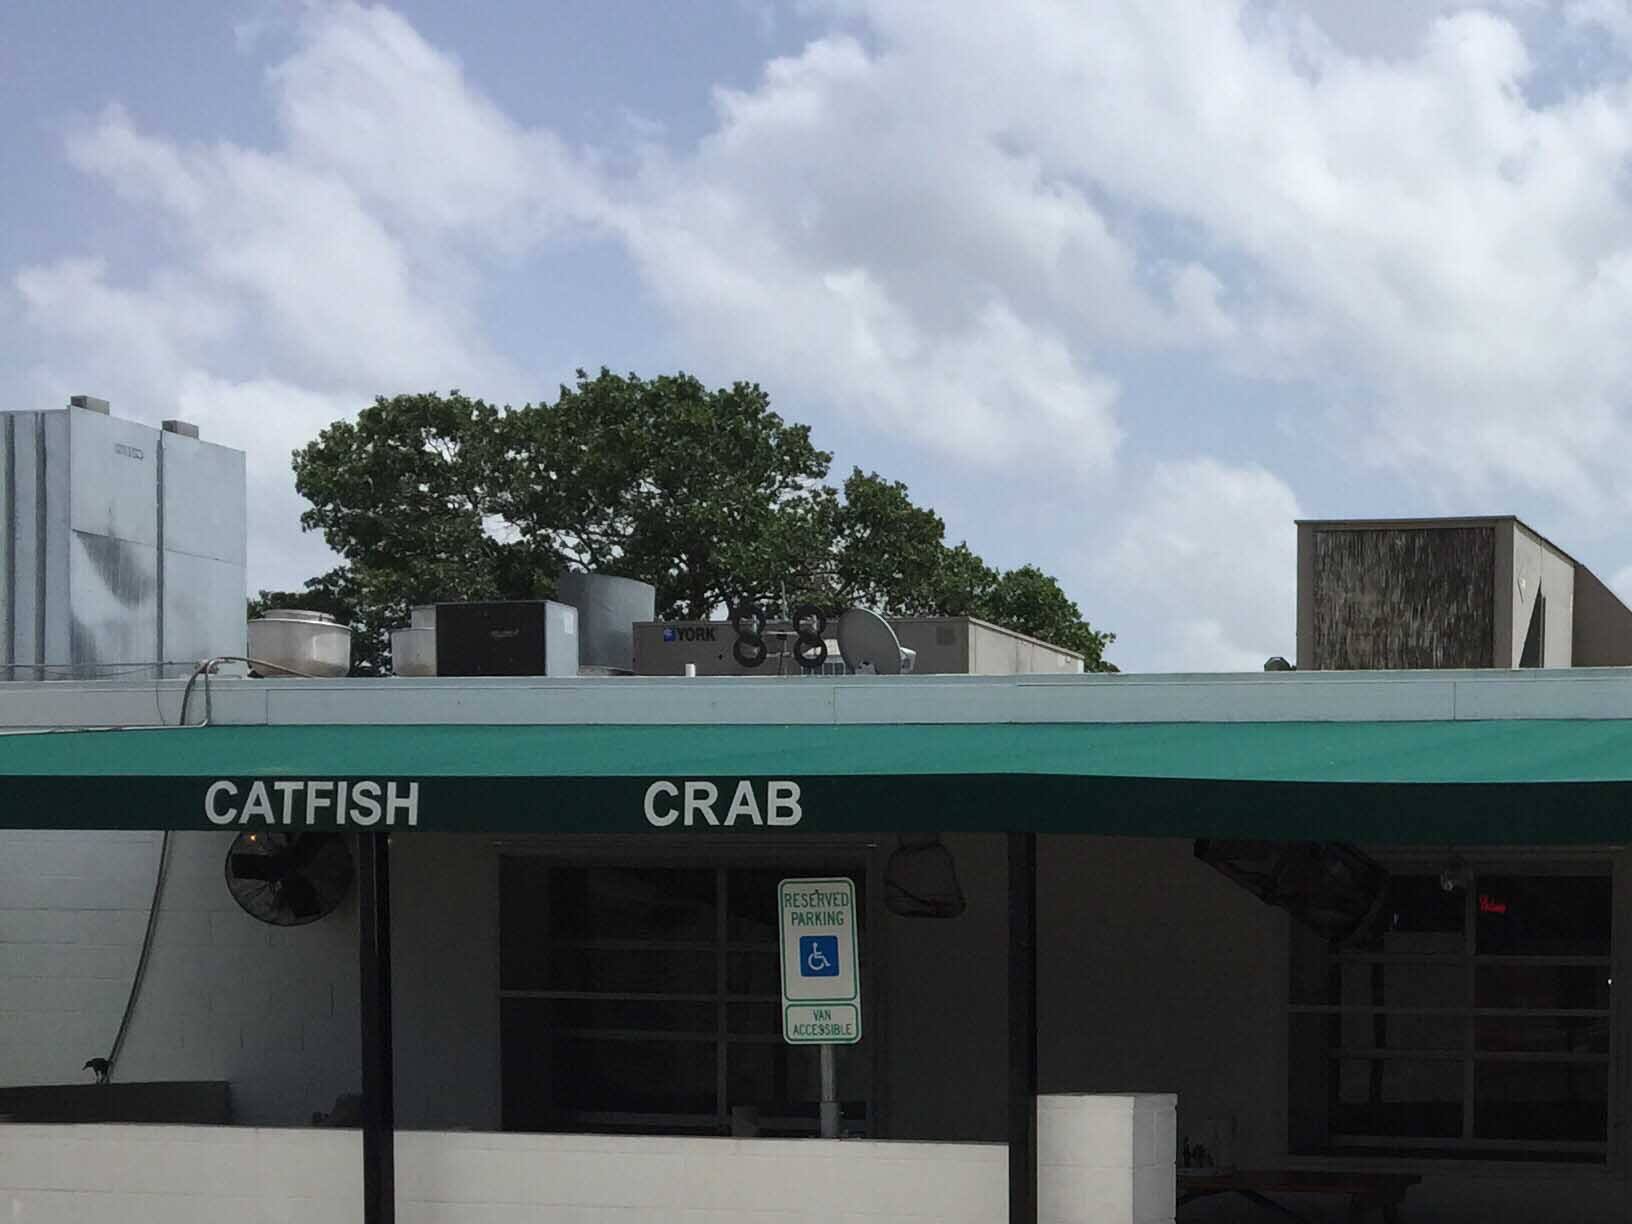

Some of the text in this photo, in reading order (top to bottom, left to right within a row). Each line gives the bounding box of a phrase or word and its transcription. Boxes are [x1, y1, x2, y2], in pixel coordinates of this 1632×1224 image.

[677, 626, 716, 642] YORK
[204, 780, 420, 826] CATFISH
[643, 780, 802, 827] CRAB
[783, 891, 850, 909] RESERVED
[790, 910, 845, 927] PARKING
[812, 1009, 832, 1022] VAN
[792, 1023, 852, 1036] ACCESSIBLE
